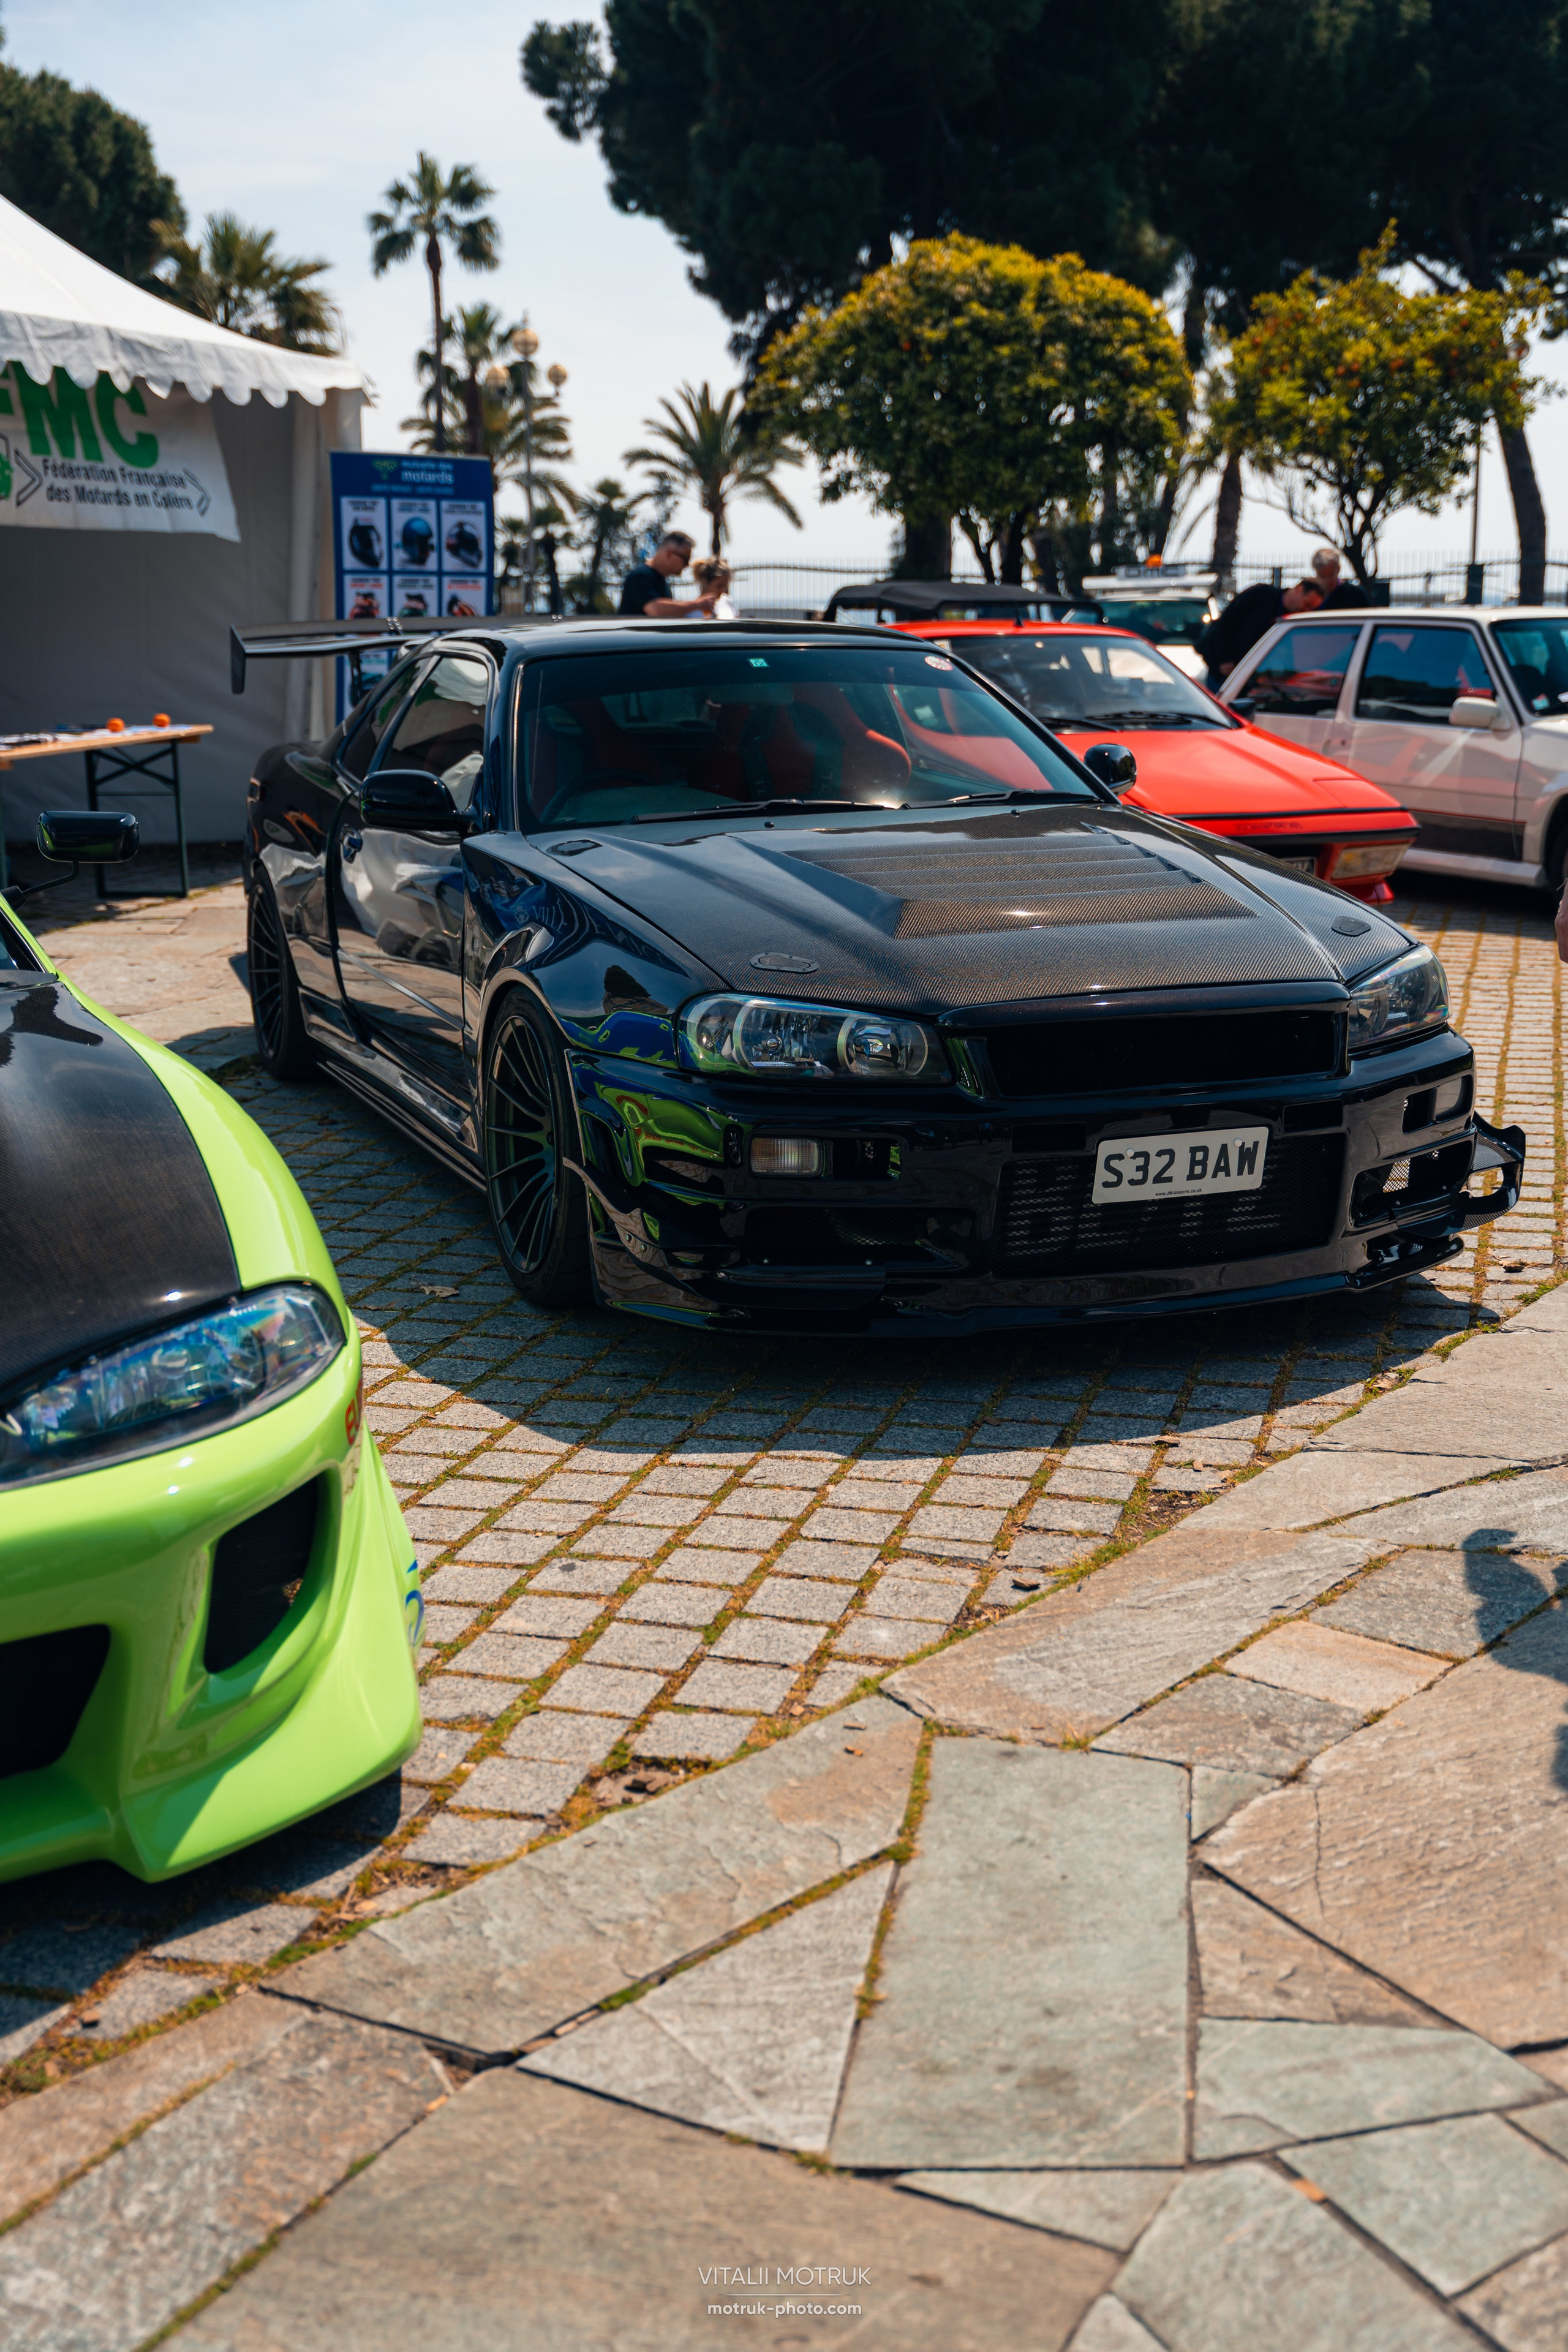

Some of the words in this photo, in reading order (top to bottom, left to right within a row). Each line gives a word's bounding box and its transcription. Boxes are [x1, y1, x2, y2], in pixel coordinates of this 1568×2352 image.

[42, 458, 118, 483] Fédération
[119, 466, 186, 489] Française
[401, 470, 454, 484] motards
[46, 483, 70, 502] des
[74, 484, 132, 506] Motards
[134, 492, 151, 507] en
[153, 491, 193, 510] Colère
[1102, 1148, 1175, 1188] S32
[1186, 1140, 1259, 1182] BAW
